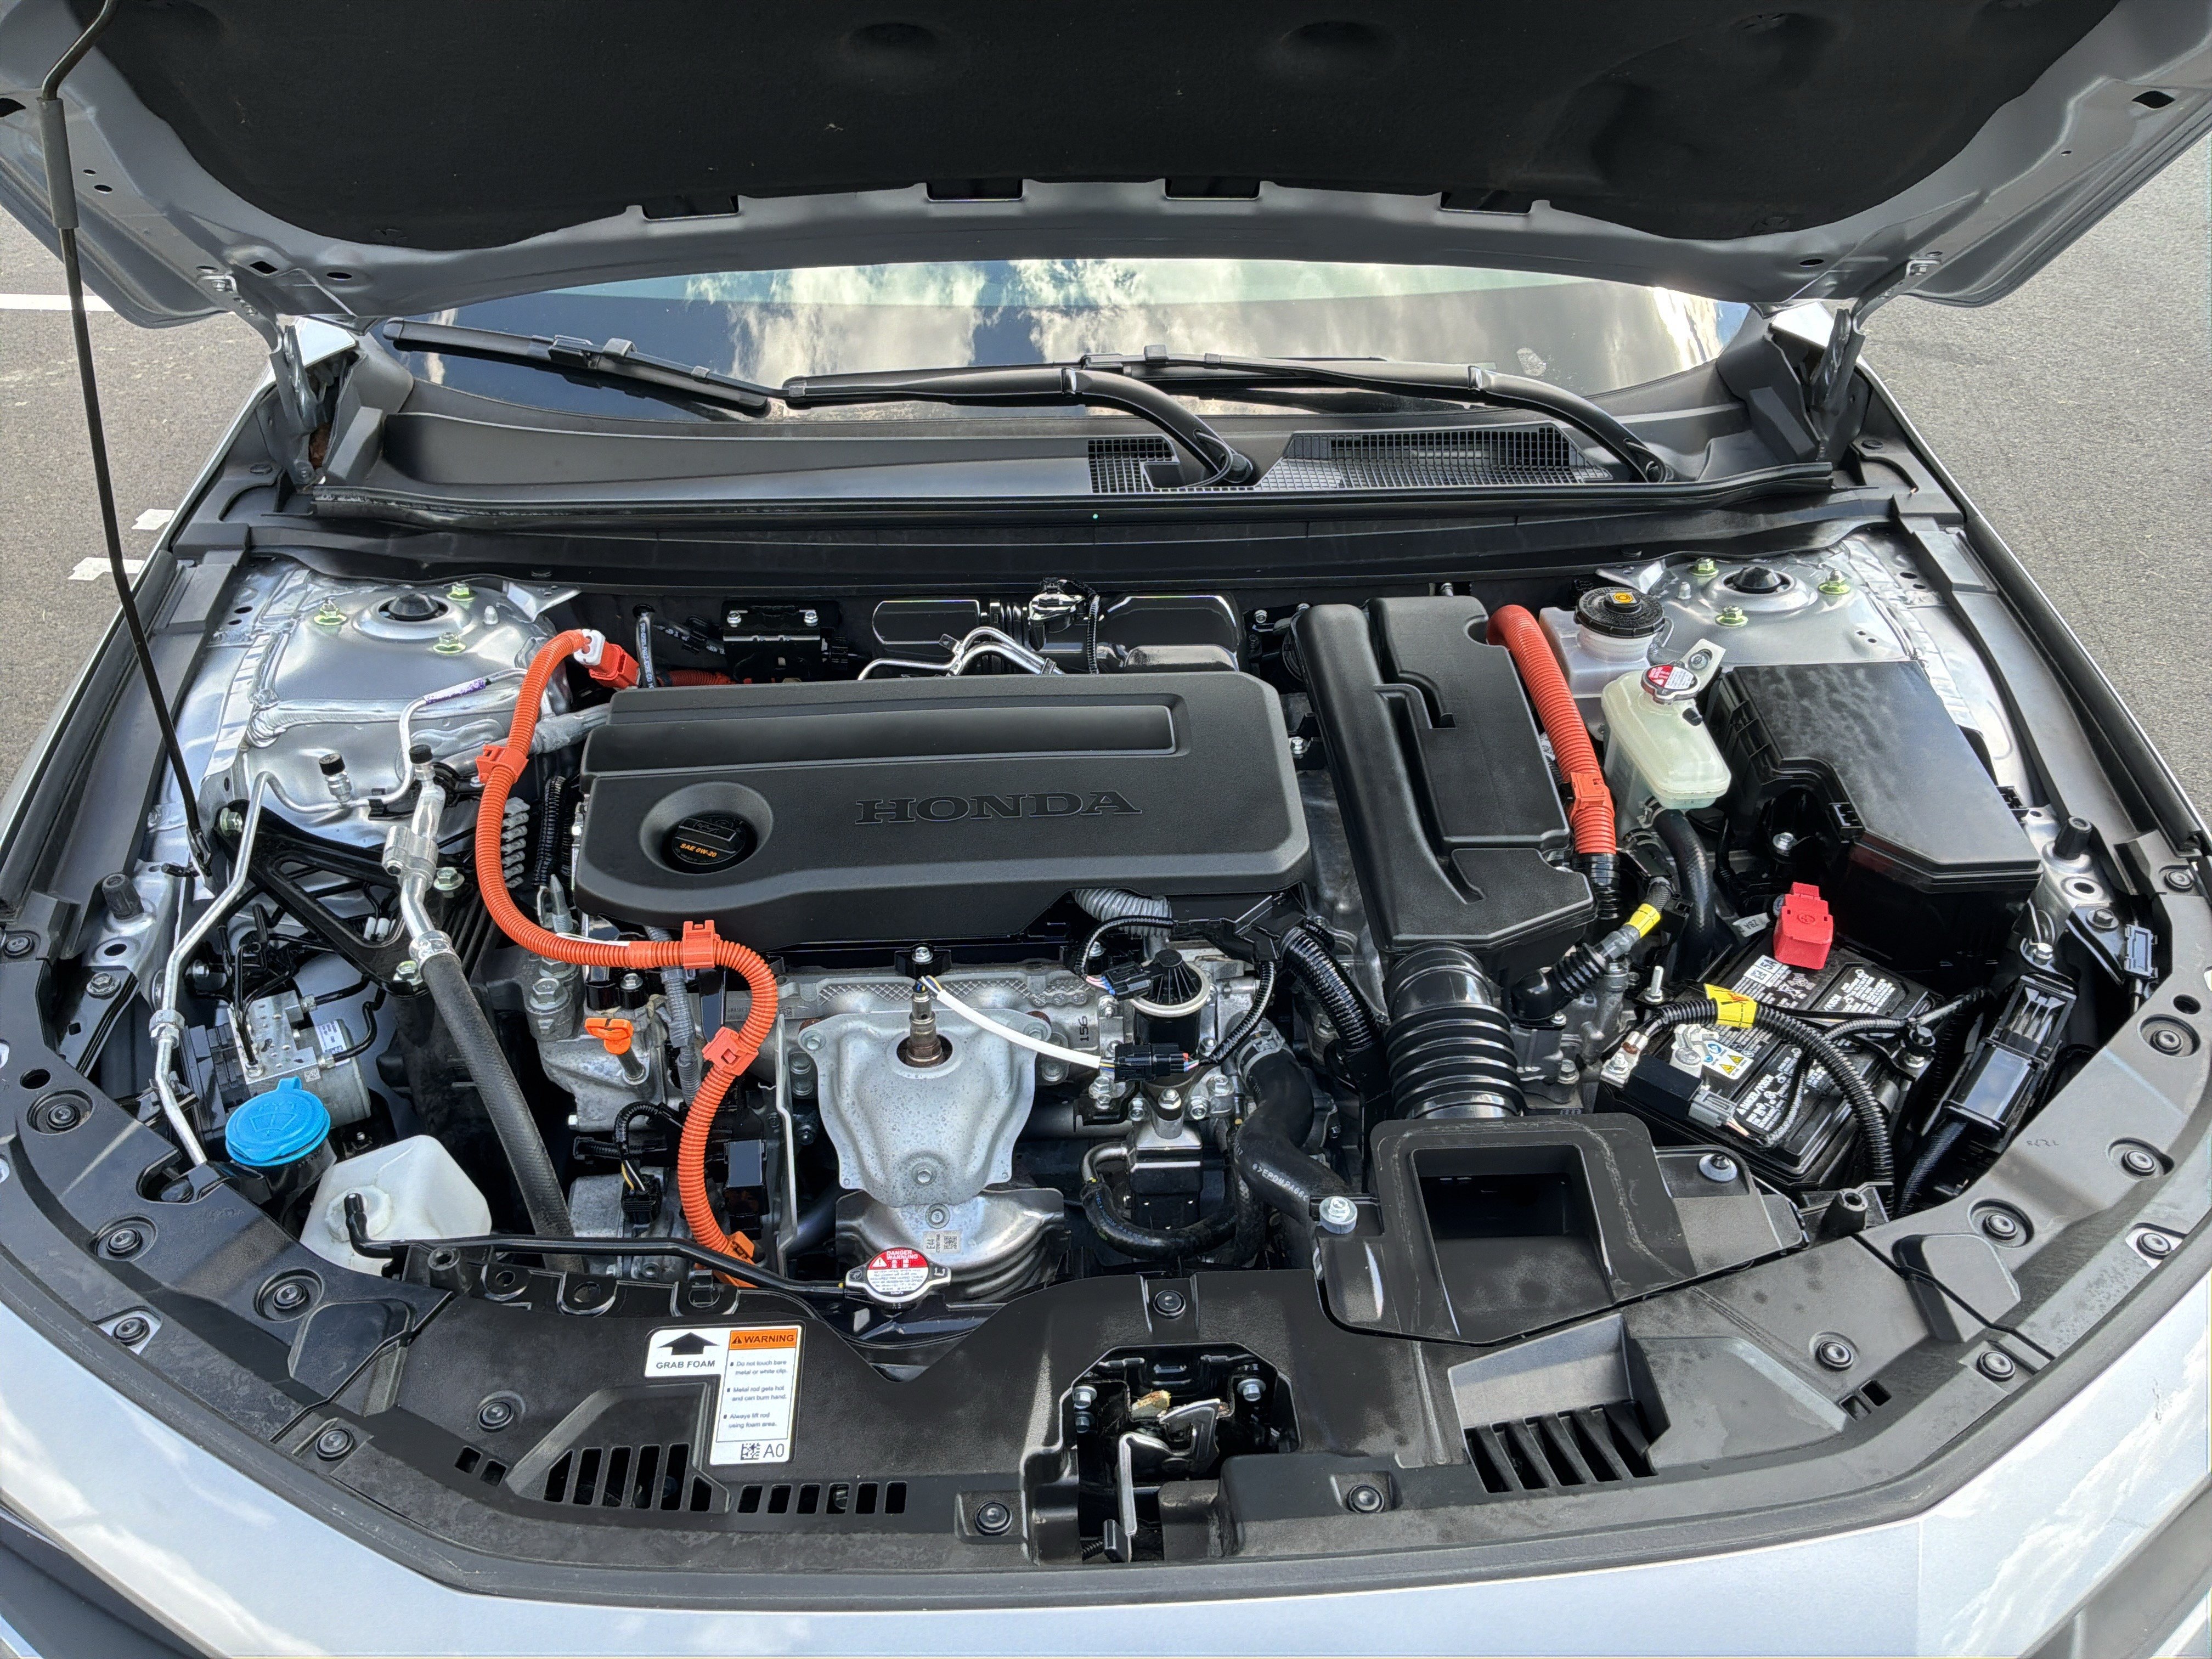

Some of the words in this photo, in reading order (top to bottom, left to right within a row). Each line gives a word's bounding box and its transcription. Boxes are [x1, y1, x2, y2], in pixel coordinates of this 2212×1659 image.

[855, 790, 1142, 825] HONDA
[680, 843, 696, 852] SAE
[695, 848, 718, 857] 0W-20
[1078, 1015, 1089, 1041] 156
[744, 1334, 794, 1343] WARNING
[686, 1360, 715, 1369] FOAM
[763, 1443, 785, 1458] A0
